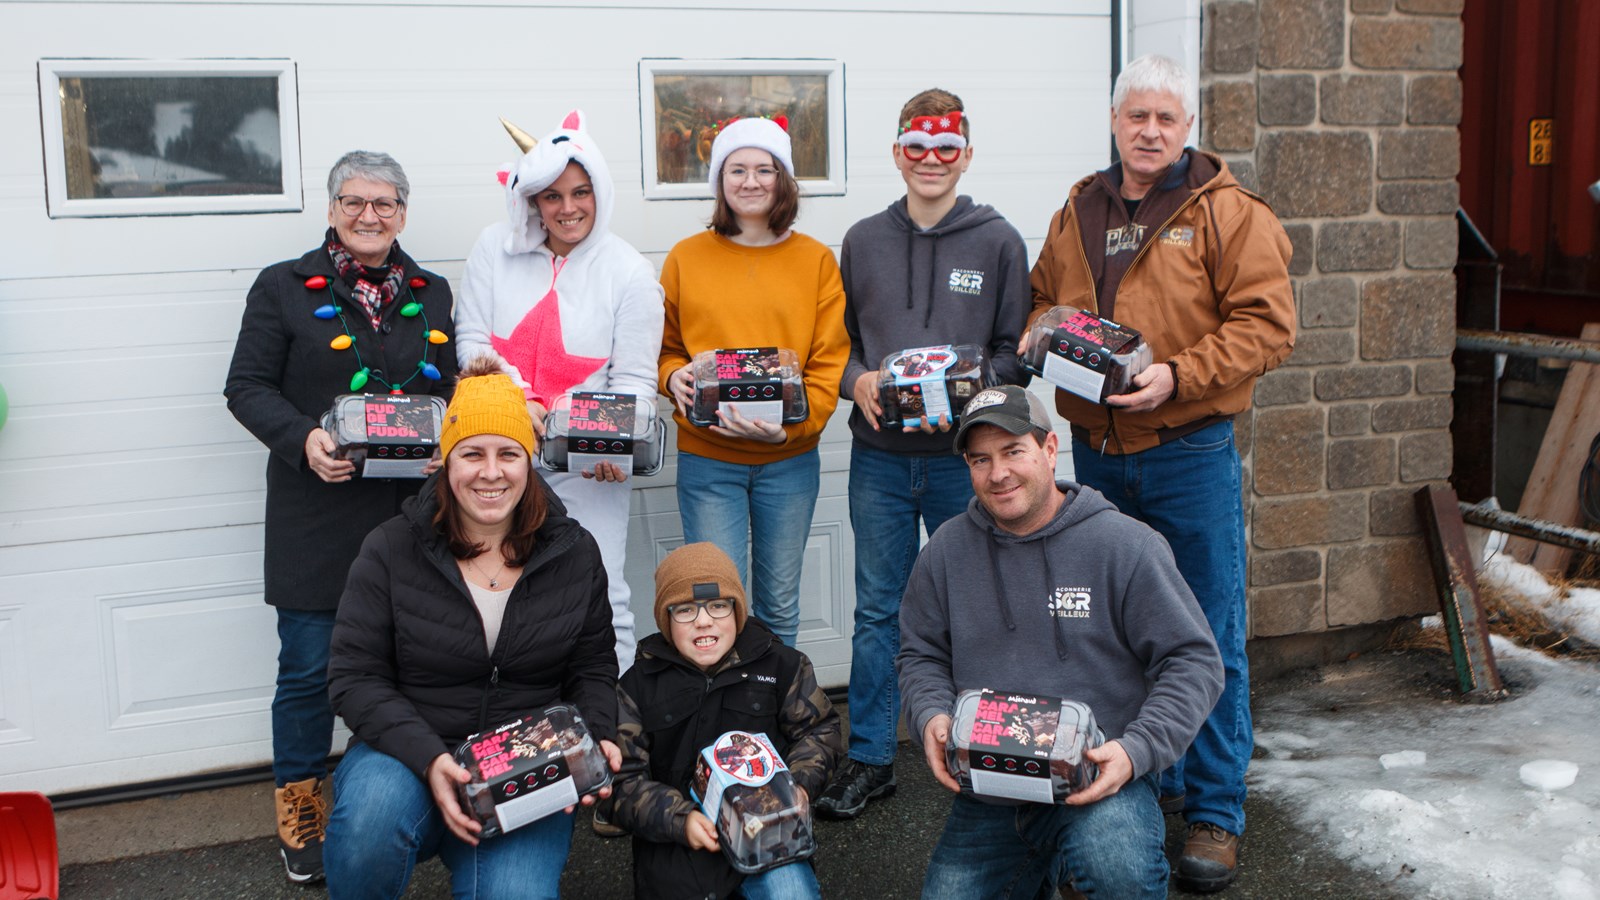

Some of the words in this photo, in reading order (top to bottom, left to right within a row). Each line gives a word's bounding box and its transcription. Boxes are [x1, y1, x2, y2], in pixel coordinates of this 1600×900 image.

[949, 272, 983, 290] SCR
[950, 286, 982, 295] VEILLEUX
[365, 403, 396, 414] FUD
[571, 399, 600, 410] FUD
[1048, 591, 1091, 611] SCR
[1049, 610, 1090, 618] VEILLEUX
[978, 699, 1019, 714] CARA
[976, 709, 1006, 723] MEL
[471, 731, 511, 753] CARA
[970, 732, 1000, 746] MEL
[473, 743, 506, 761] MEL
[481, 762, 514, 781] MEL
